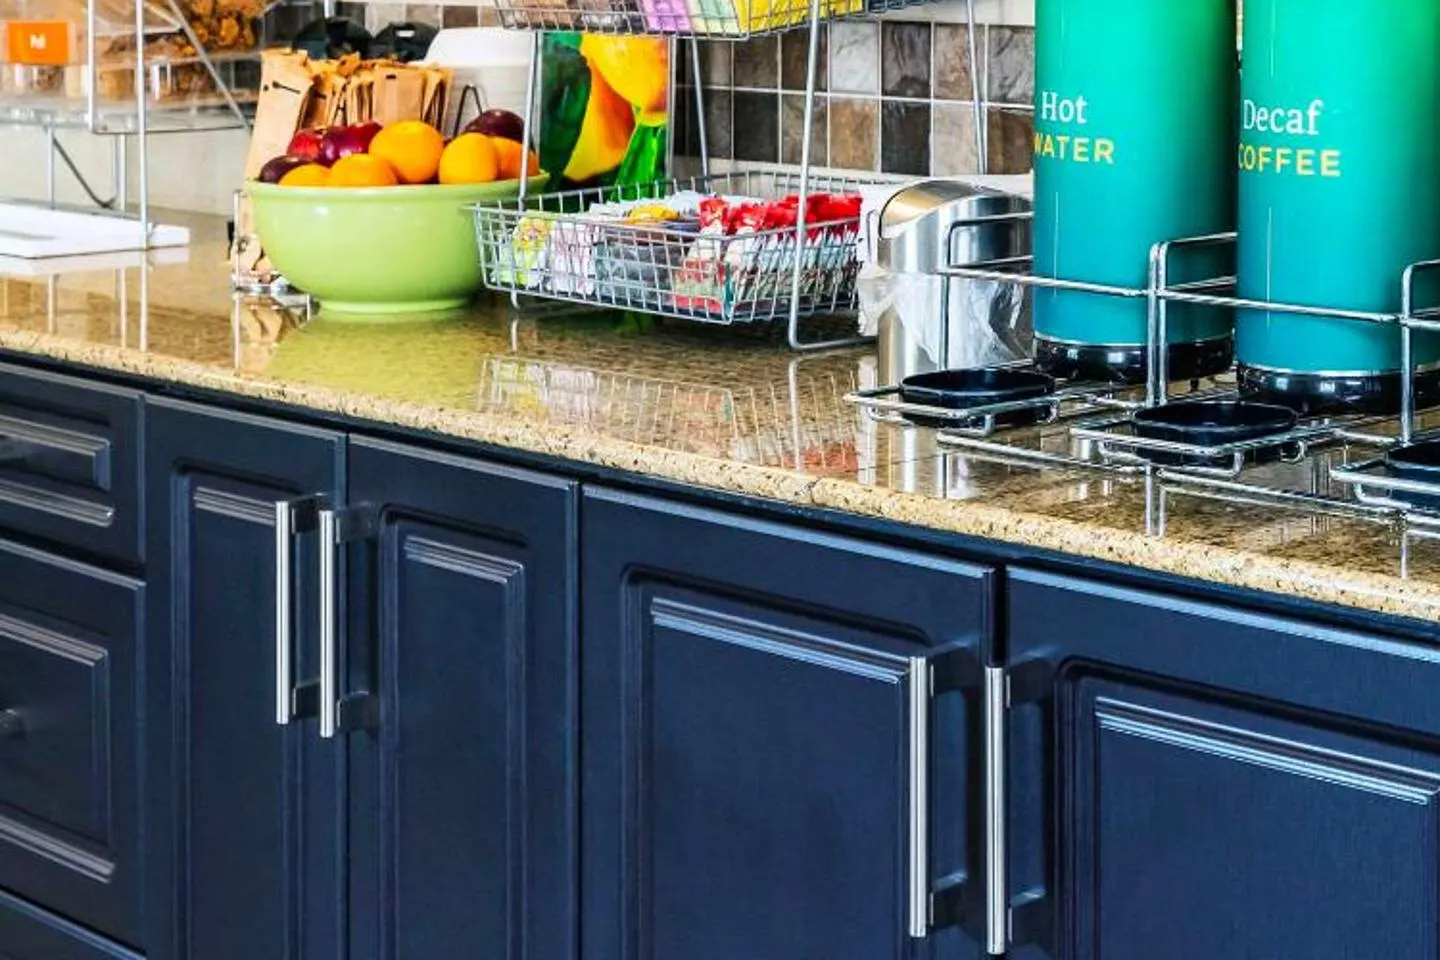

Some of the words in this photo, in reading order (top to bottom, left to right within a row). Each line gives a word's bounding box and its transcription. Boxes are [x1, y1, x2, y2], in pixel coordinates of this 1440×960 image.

[1041, 91, 1088, 125] Hot
[1243, 98, 1324, 136] Decaf
[1238, 143, 1342, 178] COFFEE
